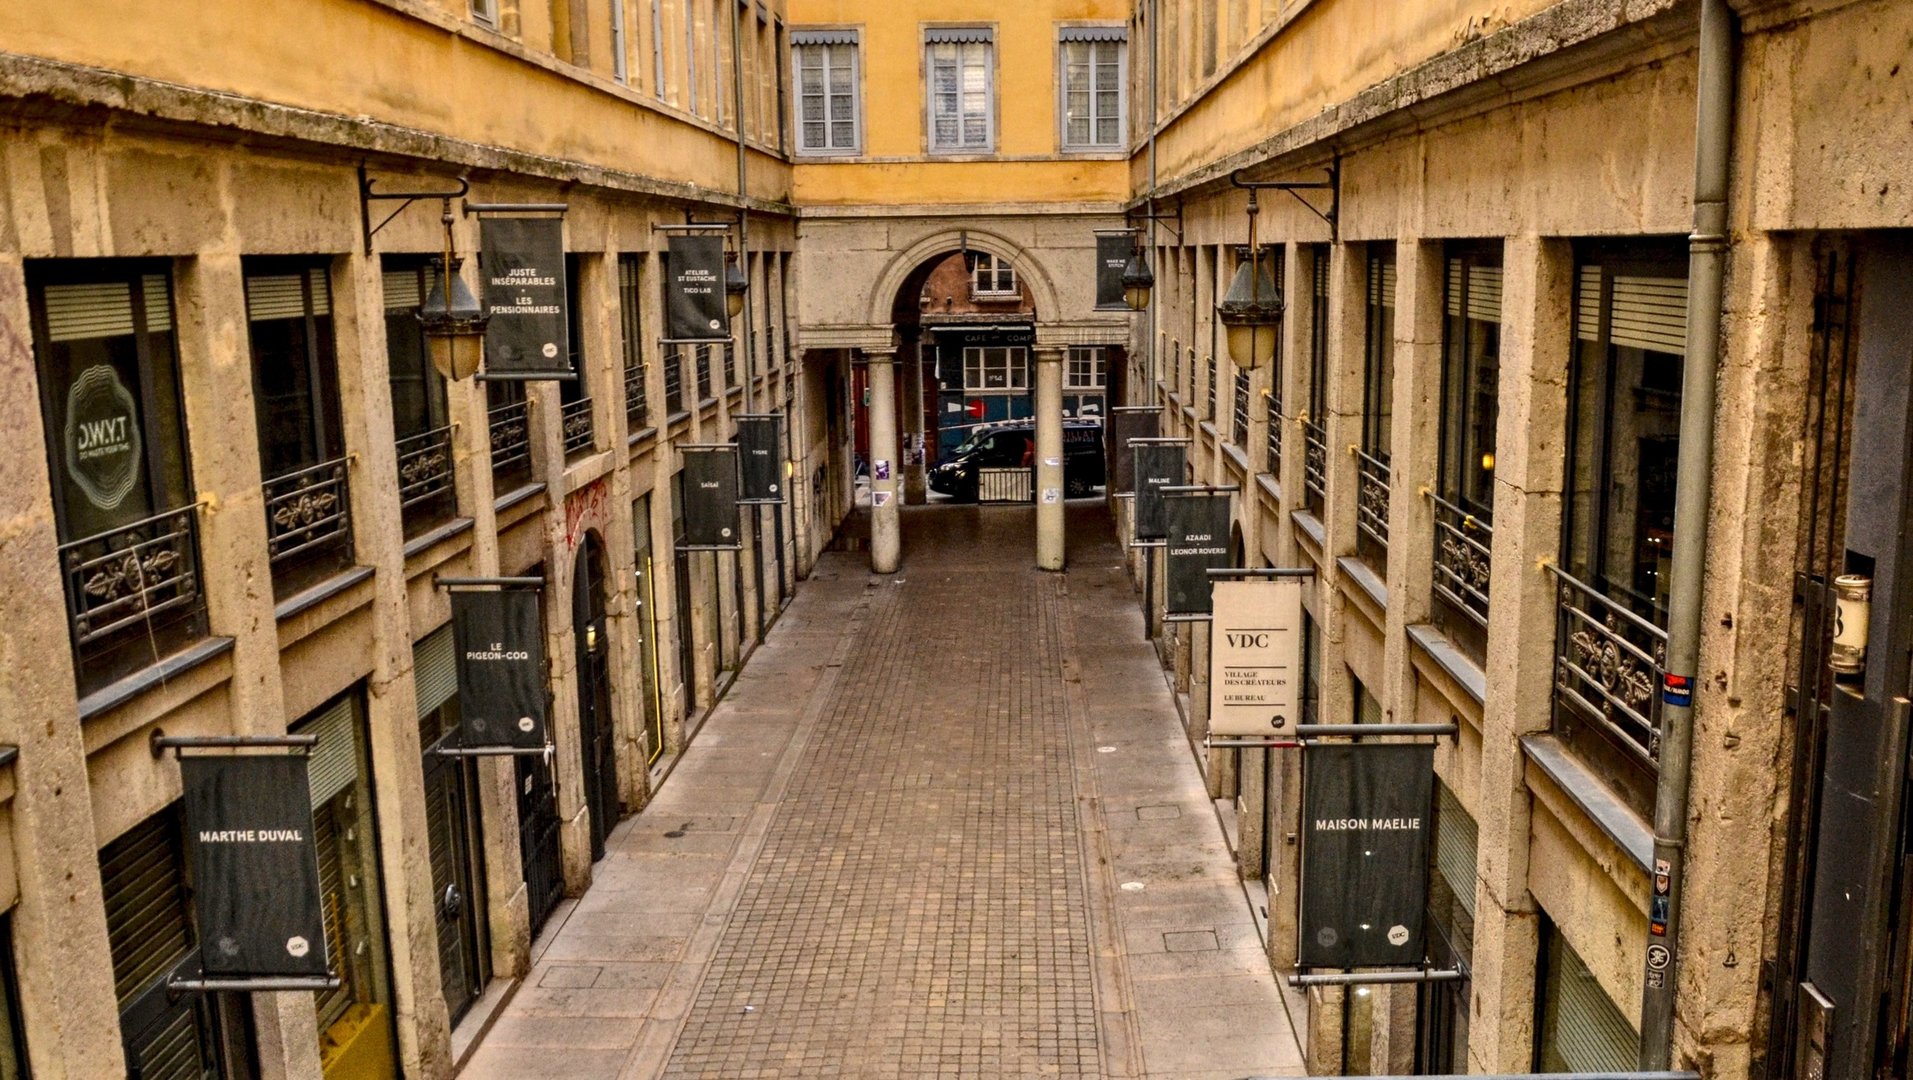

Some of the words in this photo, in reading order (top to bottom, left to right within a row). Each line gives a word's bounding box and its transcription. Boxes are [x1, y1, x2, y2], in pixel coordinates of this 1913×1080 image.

[509, 268, 536, 277] JUSTE
[491, 276, 556, 285] INSÉPARABLES
[515, 297, 532, 305] LES
[490, 306, 560, 314] PENSIONNAIRES
[1226, 633, 1269, 648] VDC
[490, 643, 502, 651] LE
[466, 651, 529, 660] PIGEON-COQ
[1316, 819, 1368, 830] MAISON
[1372, 818, 1421, 830] MAELIE
[200, 831, 255, 842] MARTHE
[258, 830, 303, 841] DUVAL
[1391, 931, 1406, 939] VDC
